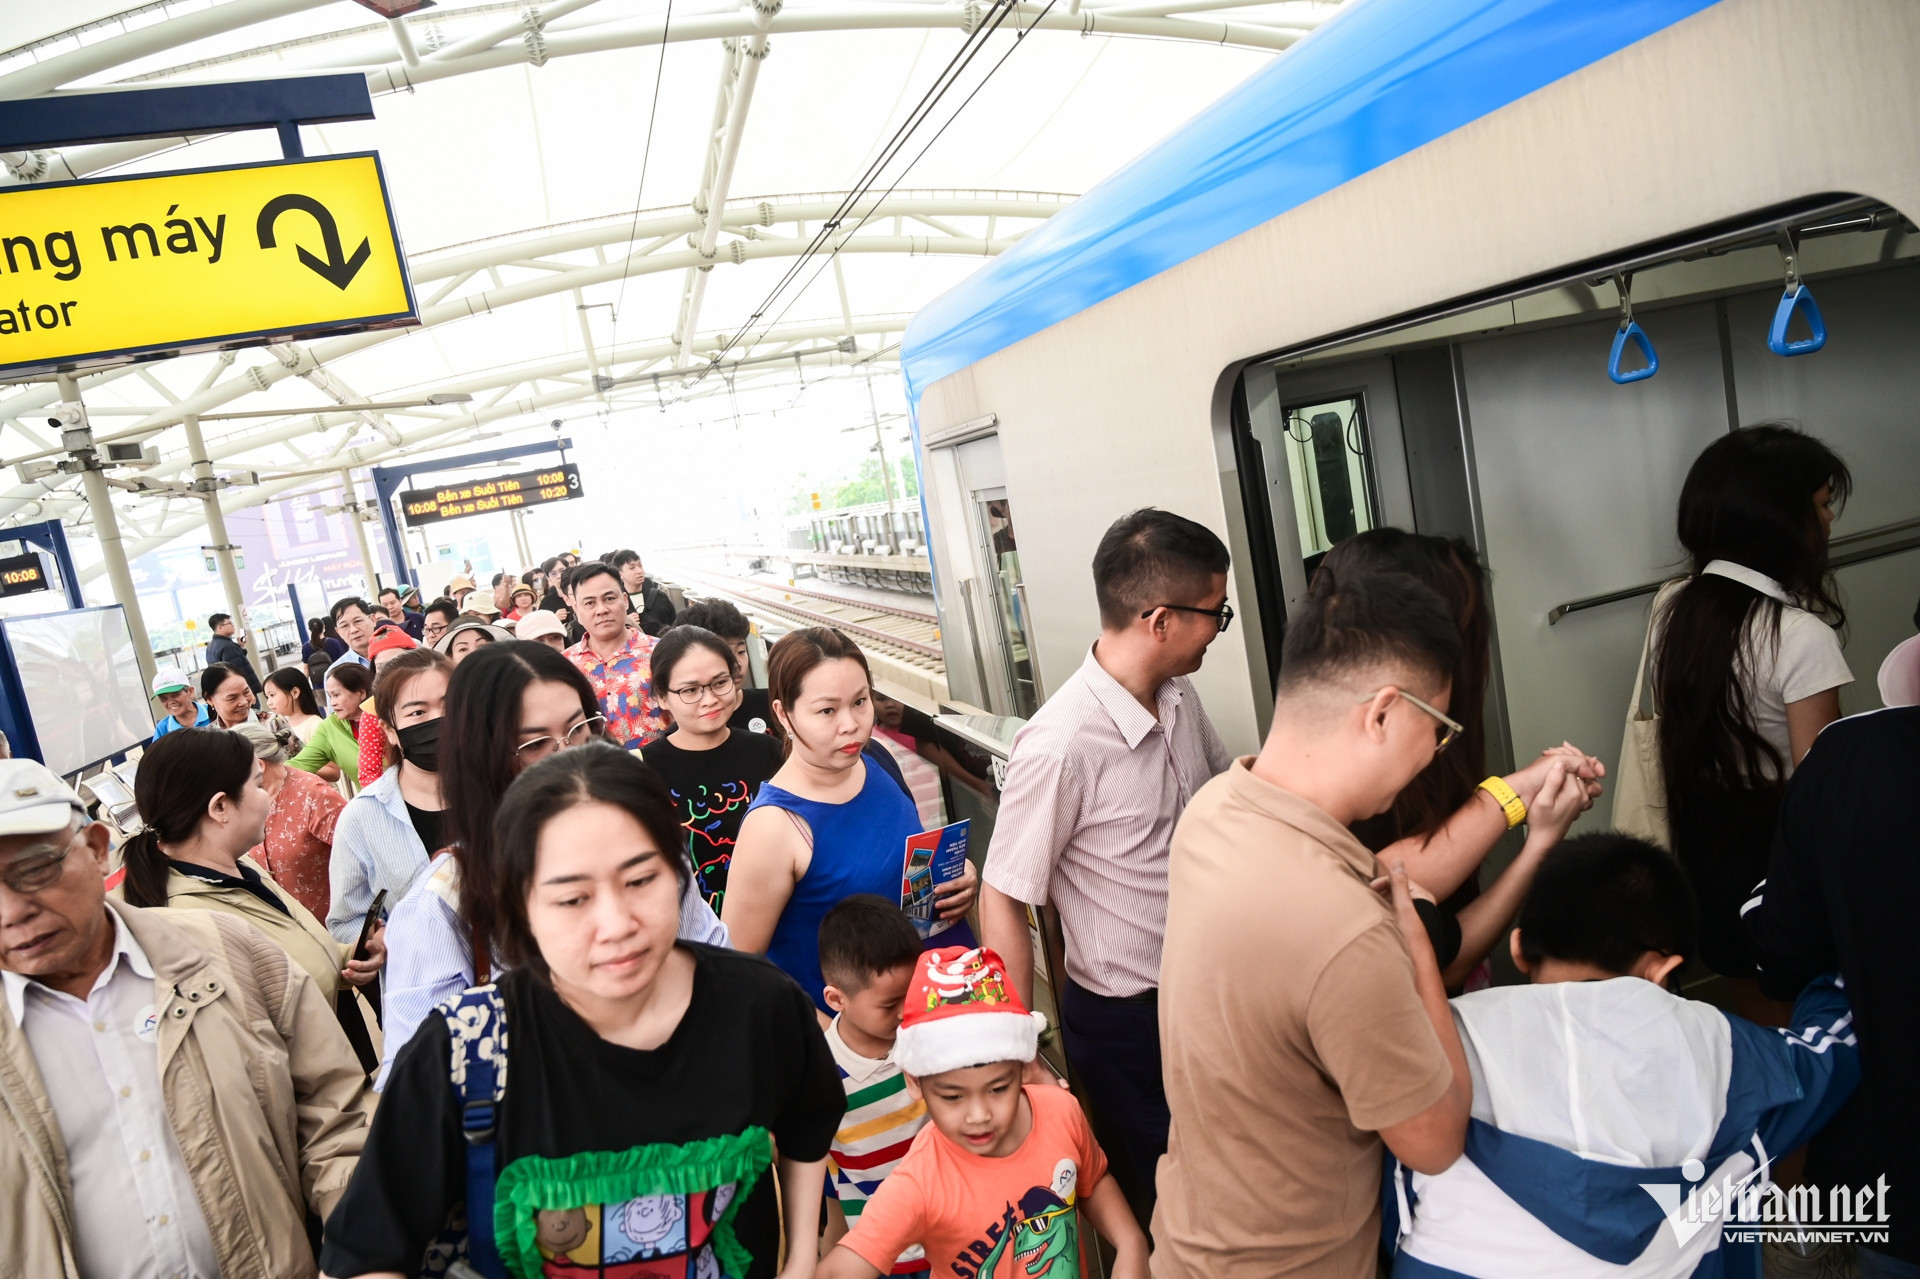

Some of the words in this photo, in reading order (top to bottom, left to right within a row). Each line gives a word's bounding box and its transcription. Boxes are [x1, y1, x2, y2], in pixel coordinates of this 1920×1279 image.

[0, 229, 82, 281] ng
[101, 204, 227, 264] máy
[460, 490, 472, 499] xe
[497, 480, 520, 492] Tiên
[537, 471, 565, 485] 10:08
[568, 473, 579, 489] 3
[408, 501, 437, 515] 10:08
[463, 504, 475, 513] xe
[500, 494, 524, 507] Tiên
[540, 485, 568, 499] 10:20
[4, 568, 37, 584] 10:08
